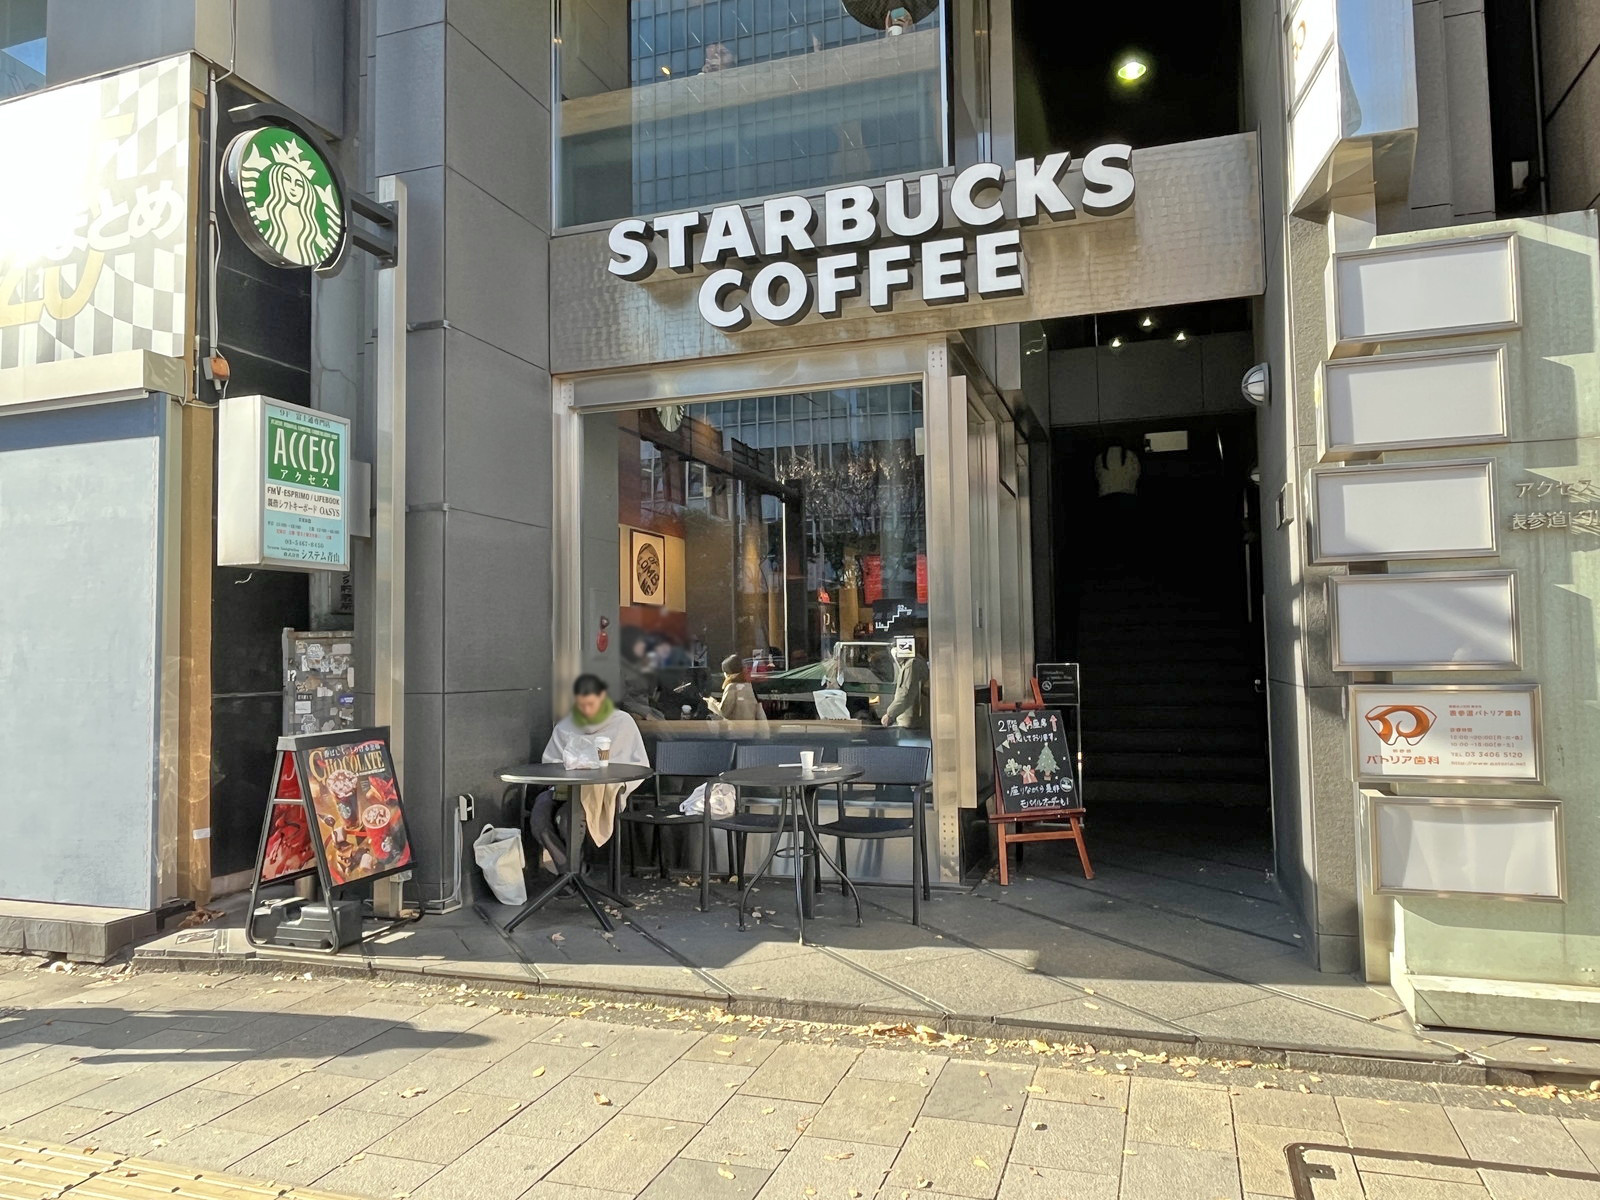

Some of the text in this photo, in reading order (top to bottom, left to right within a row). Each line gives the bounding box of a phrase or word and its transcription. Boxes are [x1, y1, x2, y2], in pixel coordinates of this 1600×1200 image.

[607, 143, 1135, 279] STARBUCKS
[698, 229, 1023, 329] COFFEE
[273, 427, 335, 476] ACCESS
[280, 469, 330, 487] アクセス
[1515, 479, 1595, 498] アクセス
[314, 495, 340, 506] LIFEBOOK
[319, 506, 340, 517] OASYS
[308, 750, 385, 785] CHOCOLATE
[1366, 755, 1440, 765] パトリア歯科
